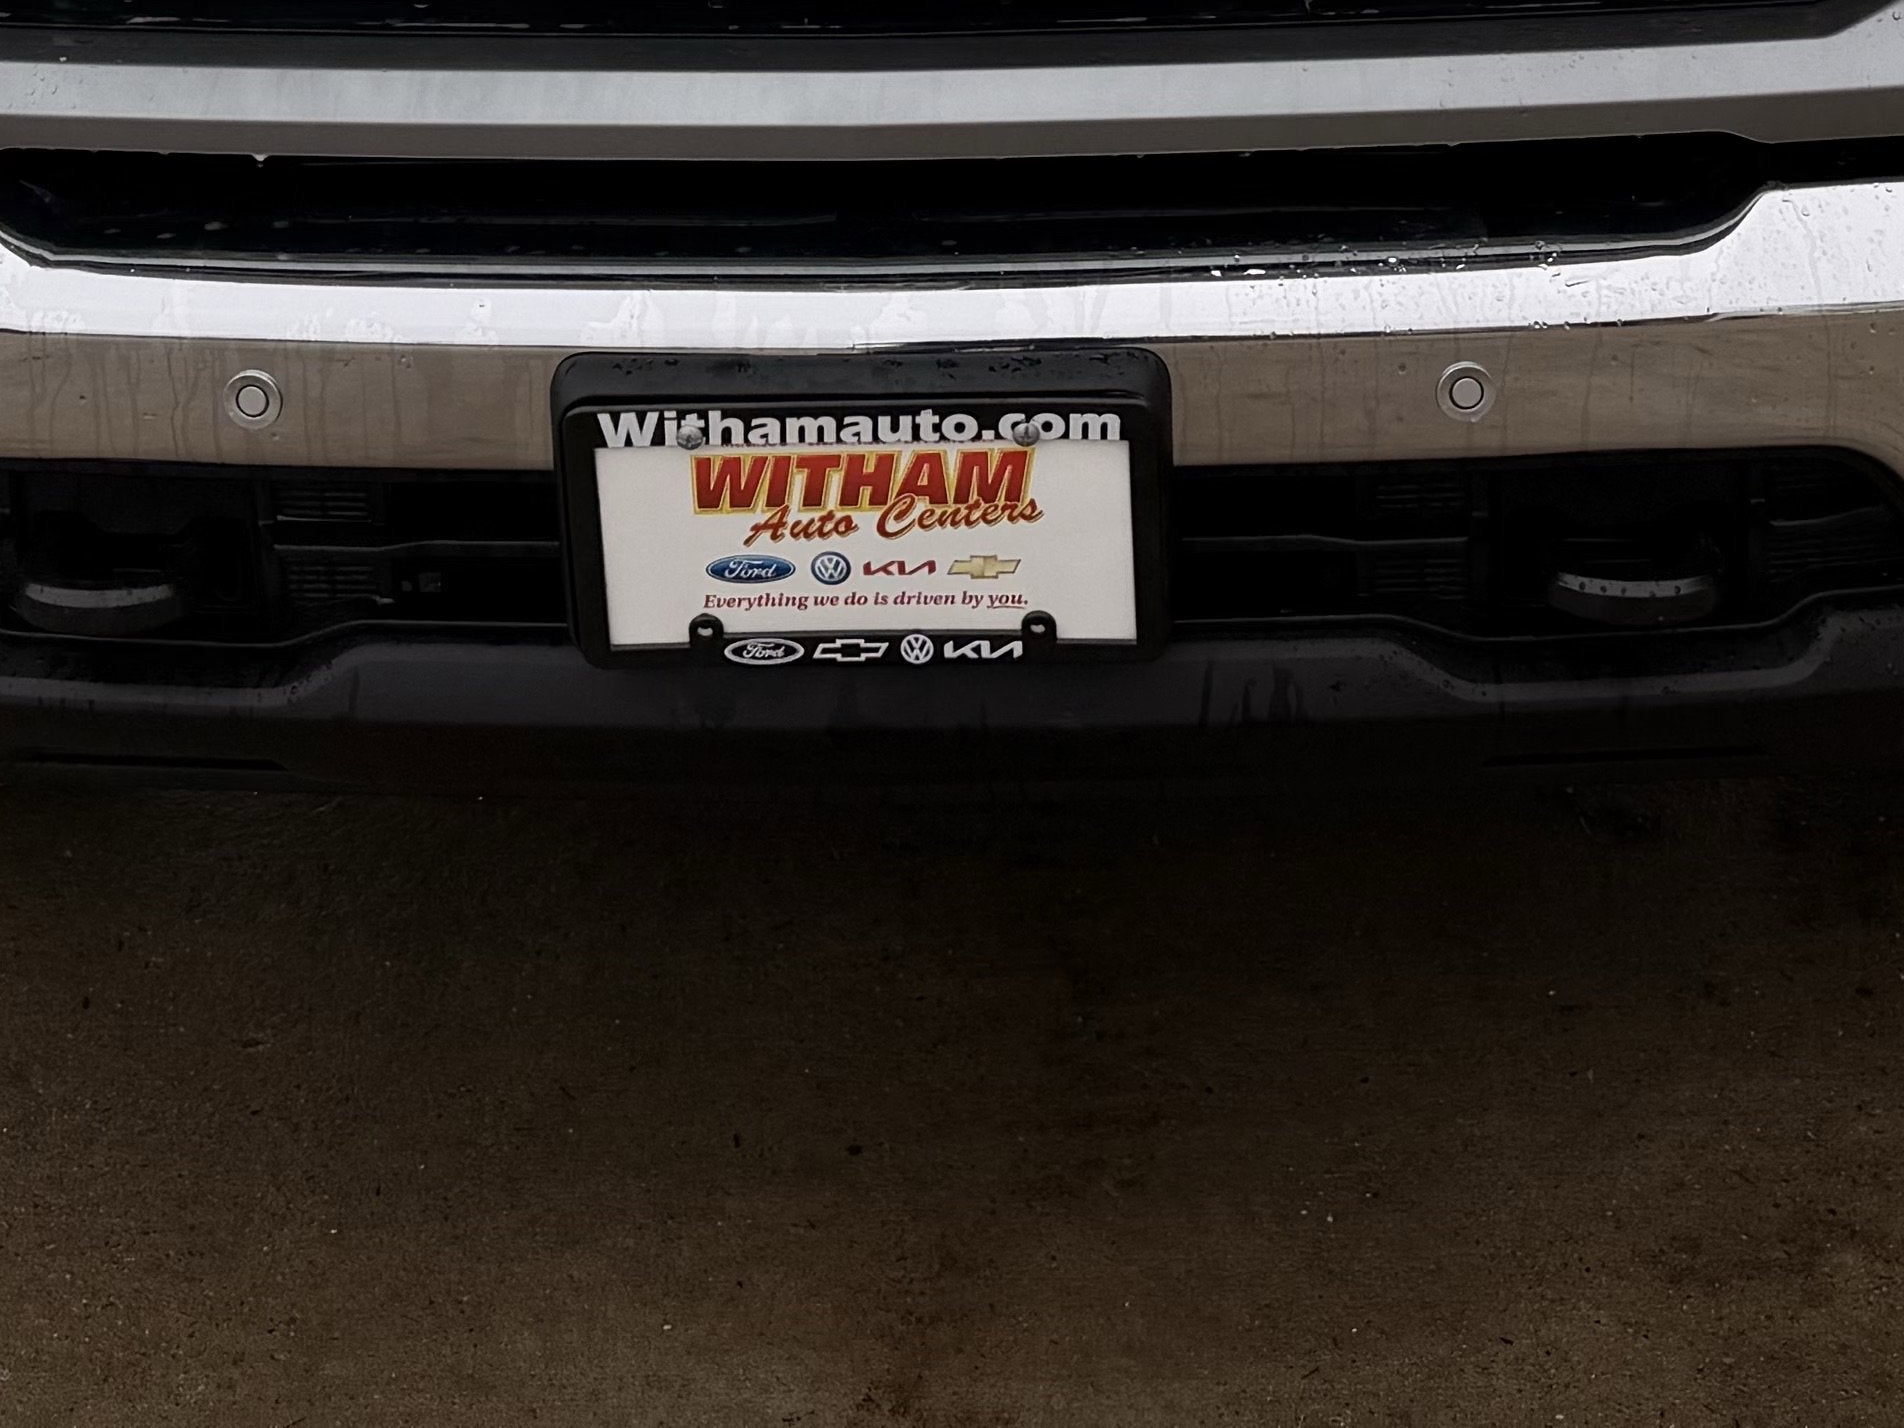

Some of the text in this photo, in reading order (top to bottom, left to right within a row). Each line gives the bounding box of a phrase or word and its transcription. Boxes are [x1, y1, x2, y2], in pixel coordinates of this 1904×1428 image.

[692, 448, 1036, 515] WITHAM
[743, 494, 1044, 547] Auto Centers
[724, 558, 778, 578] Ford
[703, 589, 1028, 611] Everything we do is driven by you.
[742, 641, 785, 658] Ford
